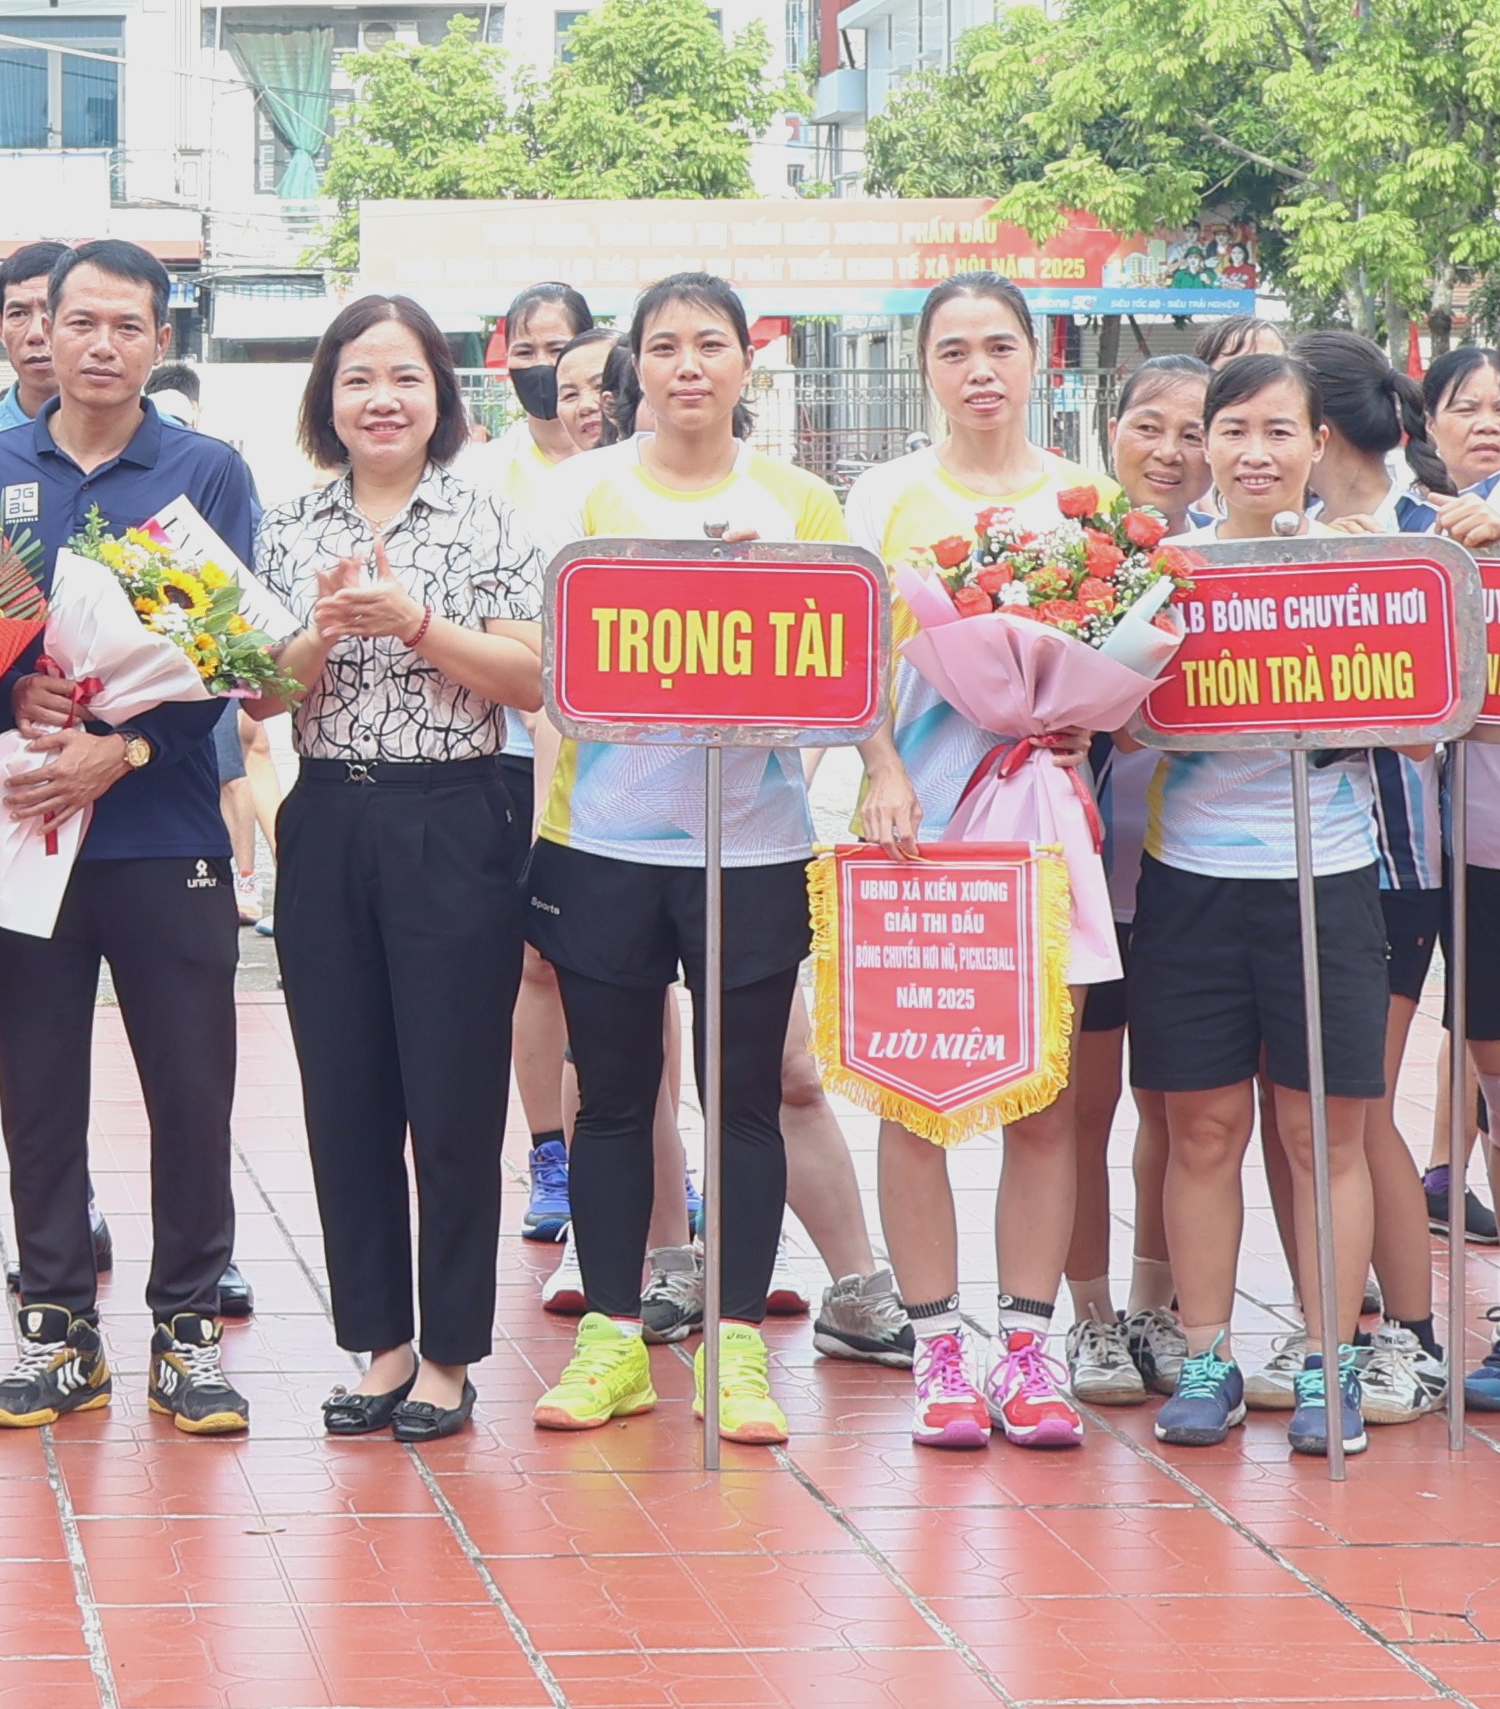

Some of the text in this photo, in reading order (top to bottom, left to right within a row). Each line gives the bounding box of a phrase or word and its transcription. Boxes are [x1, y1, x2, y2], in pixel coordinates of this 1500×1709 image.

[1040, 258, 1085, 279] 2025
[1212, 593, 1277, 633] BÓNG
[1386, 588, 1427, 625] HƠI
[592, 597, 843, 689] TRỌNG TÀI
[1181, 643, 1414, 707] THÔN TRÀ ĐÔNG
[860, 875, 1008, 902] UBND XÃ KIẾN XƯƠNG
[530, 896, 560, 915] Sports
[884, 907, 985, 934] GIẢI THI ĐẤU
[855, 940, 881, 969] BÓNG
[959, 947, 1016, 971] PICKLEBALL
[896, 983, 975, 1010] NĂM 2025
[868, 1026, 1005, 1068] LƯU NIỆM
